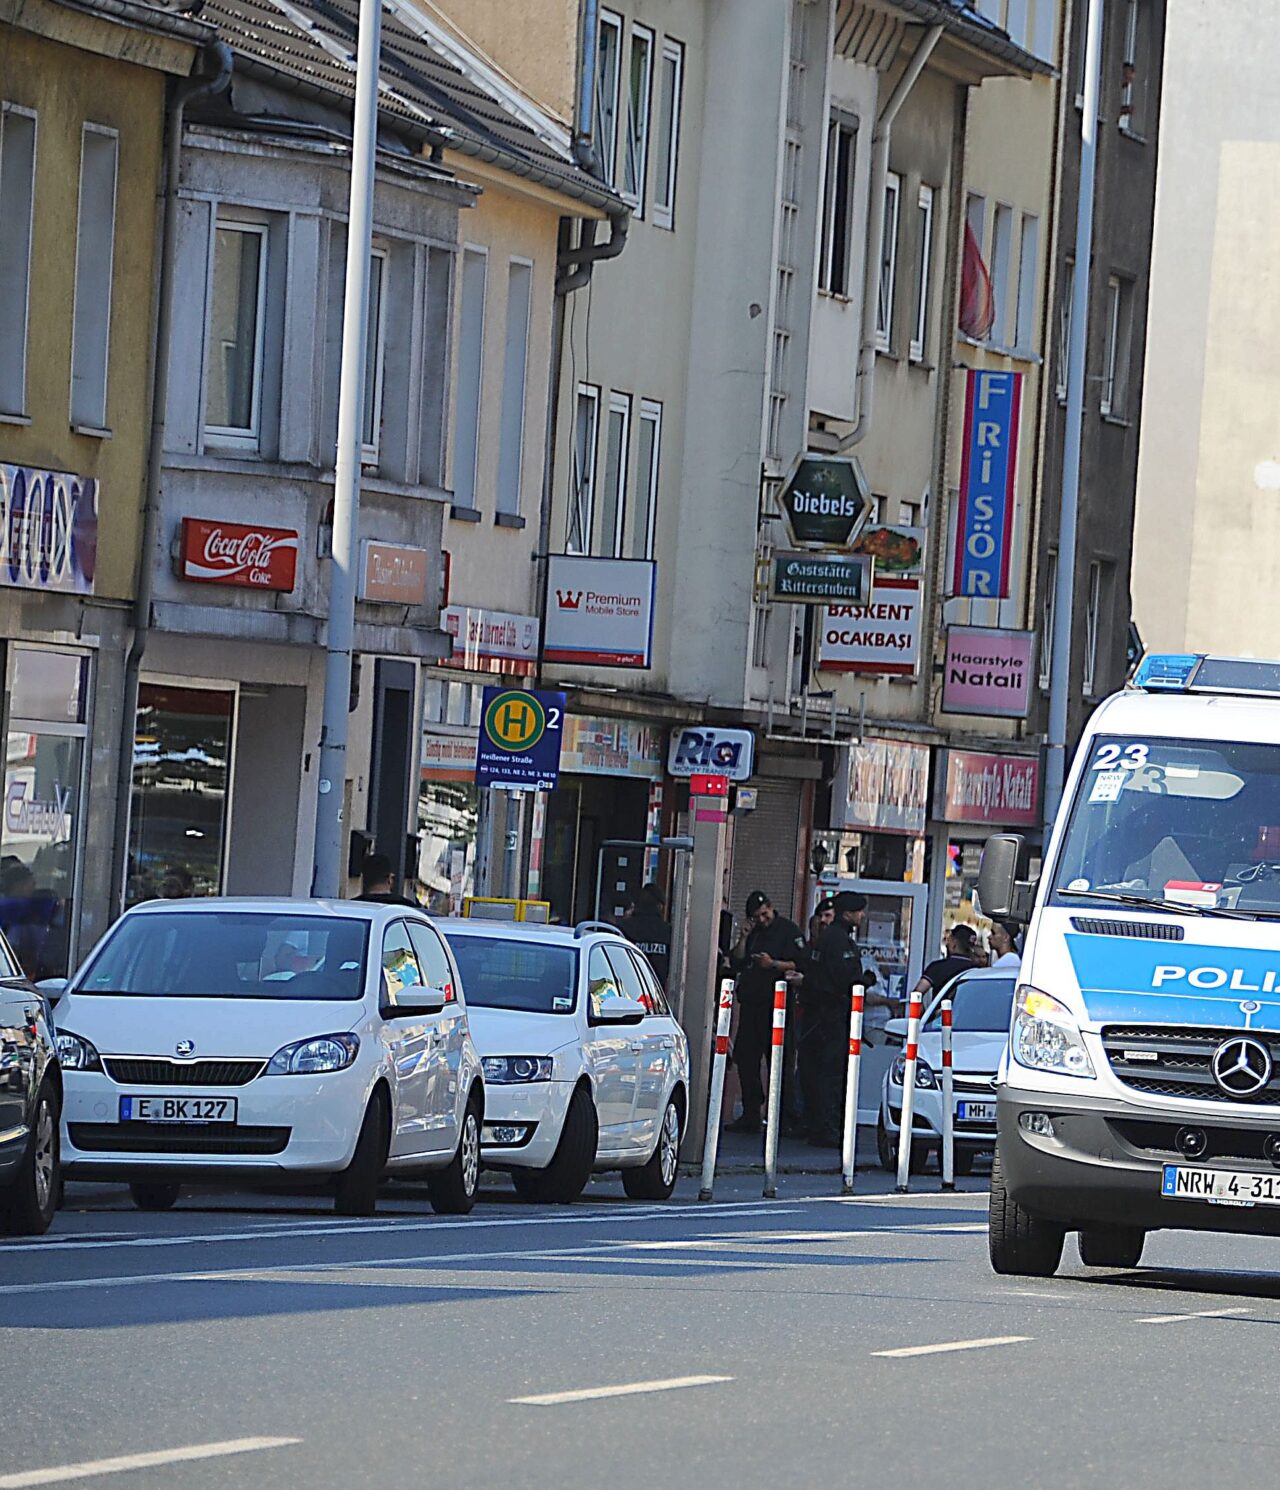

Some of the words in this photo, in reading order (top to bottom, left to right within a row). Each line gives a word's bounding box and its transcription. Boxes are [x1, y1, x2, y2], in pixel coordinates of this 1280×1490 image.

[203, 529, 275, 568] Coca-Cola
[249, 569, 272, 584] Coke
[787, 562, 852, 579] Gaststätte
[781, 579, 856, 597] Ritterstuben
[586, 591, 641, 606] Premium
[585, 605, 614, 615] Mobile
[616, 607, 639, 616] Store
[827, 603, 914, 622] BAŞKENT
[826, 630, 912, 651] OCAKBAŞI
[951, 652, 1023, 668] Haarstyle
[950, 669, 1022, 689] Natali
[502, 704, 529, 738] H
[546, 708, 560, 729] 2
[481, 753, 510, 762] Heißener
[511, 755, 533, 765] Straße
[674, 731, 743, 768] Ria
[1092, 743, 1149, 770] 23
[139, 1100, 151, 1118] E
[163, 1100, 189, 1118] BK
[192, 1101, 228, 1119] 127
[969, 1104, 986, 1118] MH
[1177, 1171, 1215, 1194] NRW
